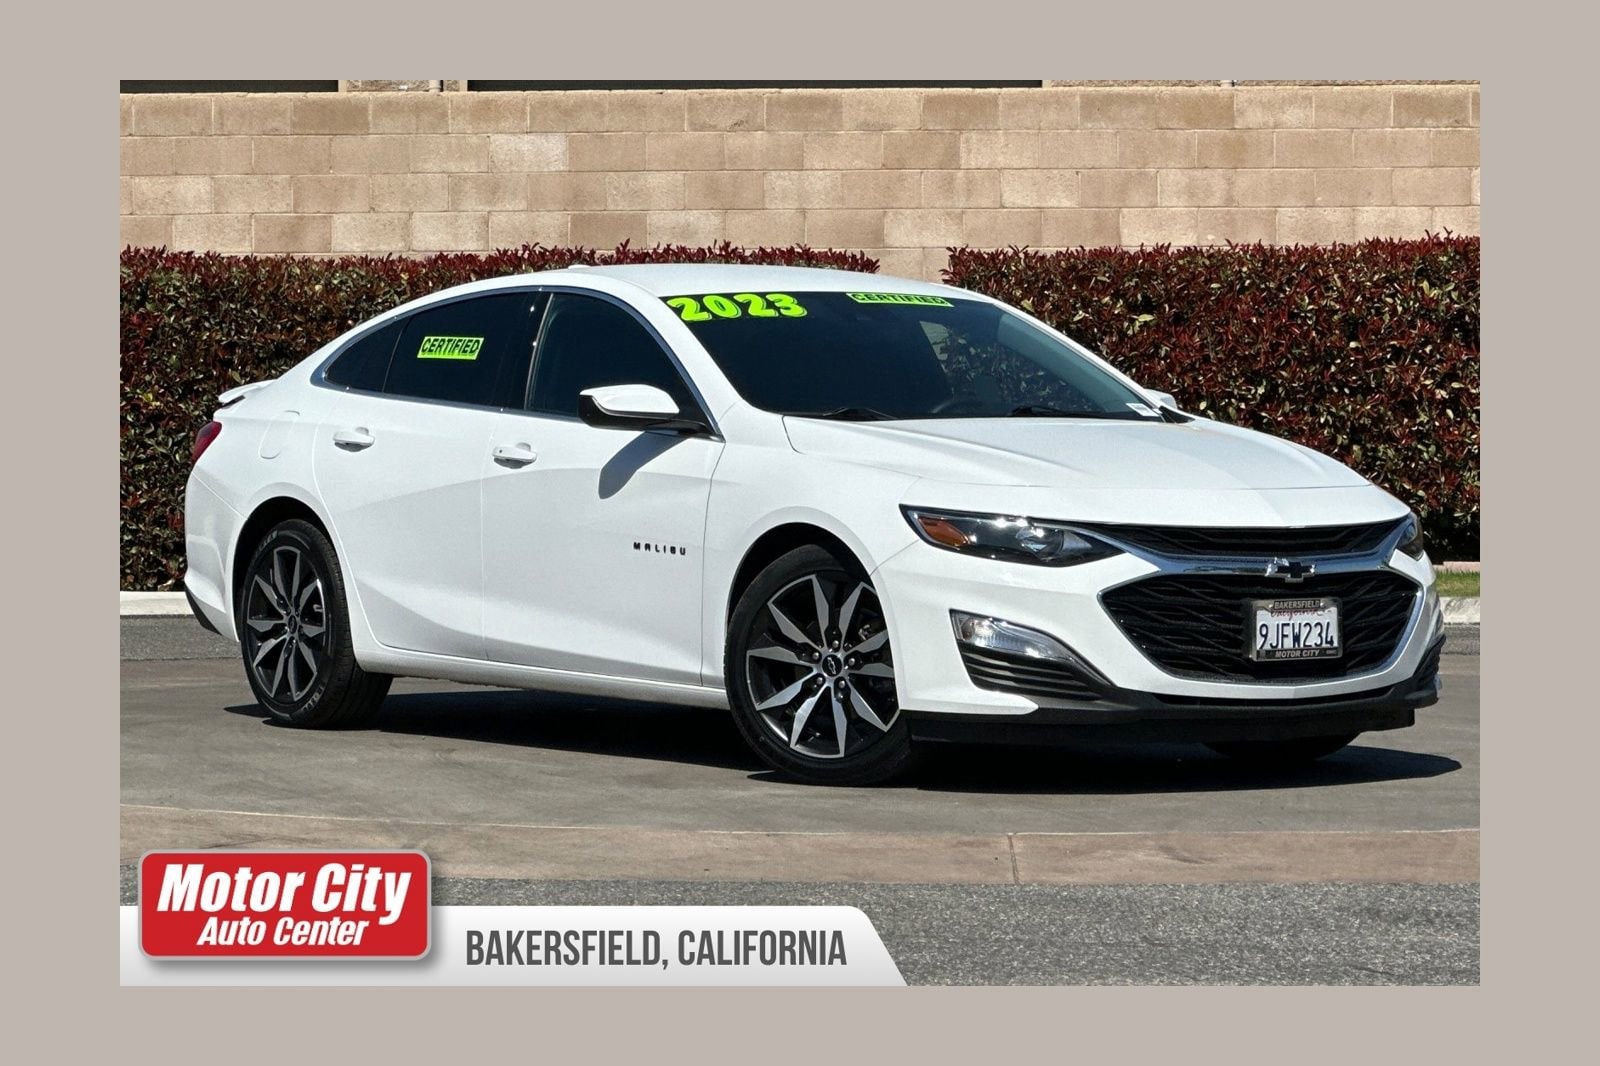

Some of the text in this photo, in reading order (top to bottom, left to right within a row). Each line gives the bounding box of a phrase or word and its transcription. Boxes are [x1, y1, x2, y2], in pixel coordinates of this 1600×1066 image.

[851, 293, 945, 305] CERTIFIED
[667, 293, 808, 321] 2023
[421, 337, 480, 355] CERTIFIED
[633, 541, 686, 556] MALIBU
[1274, 600, 1320, 609] BAKERSFIELD
[1258, 621, 1335, 650] 9JFW234
[1274, 650, 1301, 658] MOTOR
[1302, 649, 1320, 657] CITY
